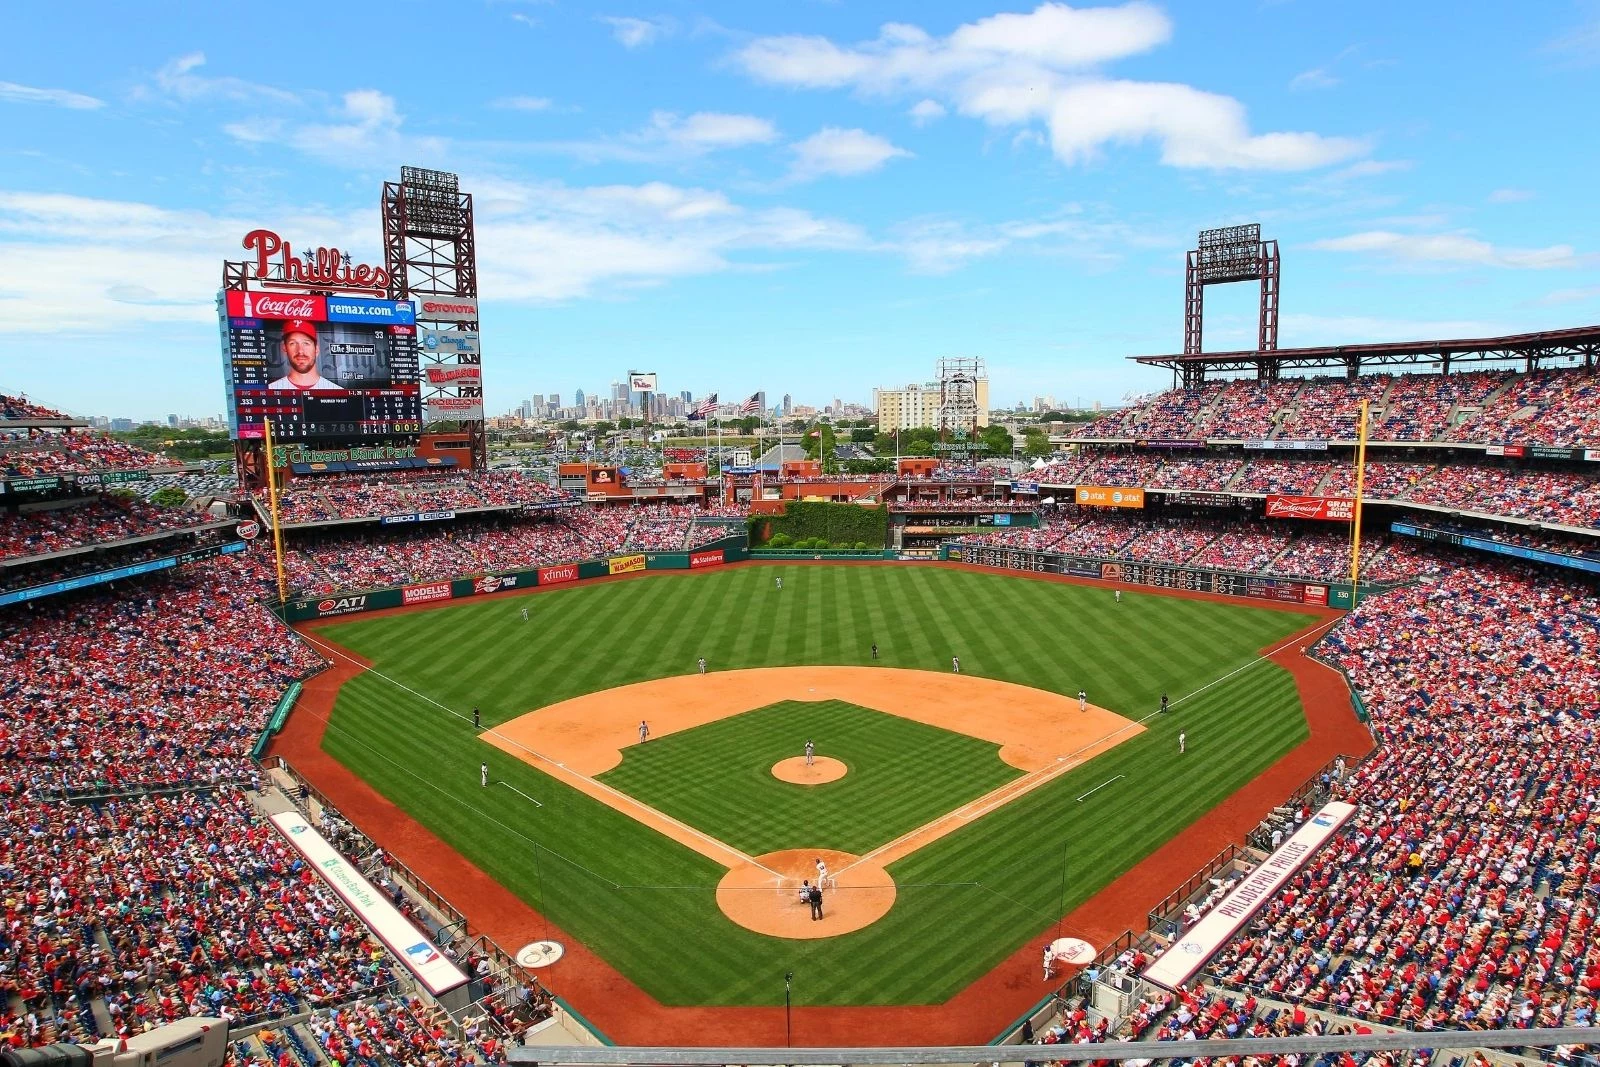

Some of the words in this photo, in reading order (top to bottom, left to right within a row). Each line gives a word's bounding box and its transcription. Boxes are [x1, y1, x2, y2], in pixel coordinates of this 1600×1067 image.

[242, 229, 390, 288] Phillies
[255, 296, 316, 318] Coca-Cola
[329, 303, 392, 318] remax.com
[436, 303, 476, 314] TOYOTA
[374, 331, 384, 339] 33
[330, 344, 345, 353] The
[346, 345, 374, 355] Inquirer
[395, 424, 400, 432] 0
[966, 441, 989, 450] Bank
[290, 450, 349, 464] Citizens
[350, 447, 385, 461] Bank
[387, 445, 416, 459] Park
[950, 450, 970, 459] Park
[77, 474, 101, 485] GOYA
[1090, 492, 1107, 500] at&t
[1123, 494, 1140, 502] at&t
[1268, 501, 1322, 511] Budweiser
[385, 515, 415, 523] GEICO
[424, 511, 452, 520] GEICO
[240, 523, 258, 533] Gulf
[543, 567, 574, 582] xfinity
[404, 584, 450, 598] MODELL'S
[334, 596, 366, 610] ATI
[405, 594, 432, 602] SPORTING
[295, 602, 307, 610] 334
[1218, 869, 1282, 919] PHILADELPHIA
[1269, 841, 1309, 870] PHILLIES
